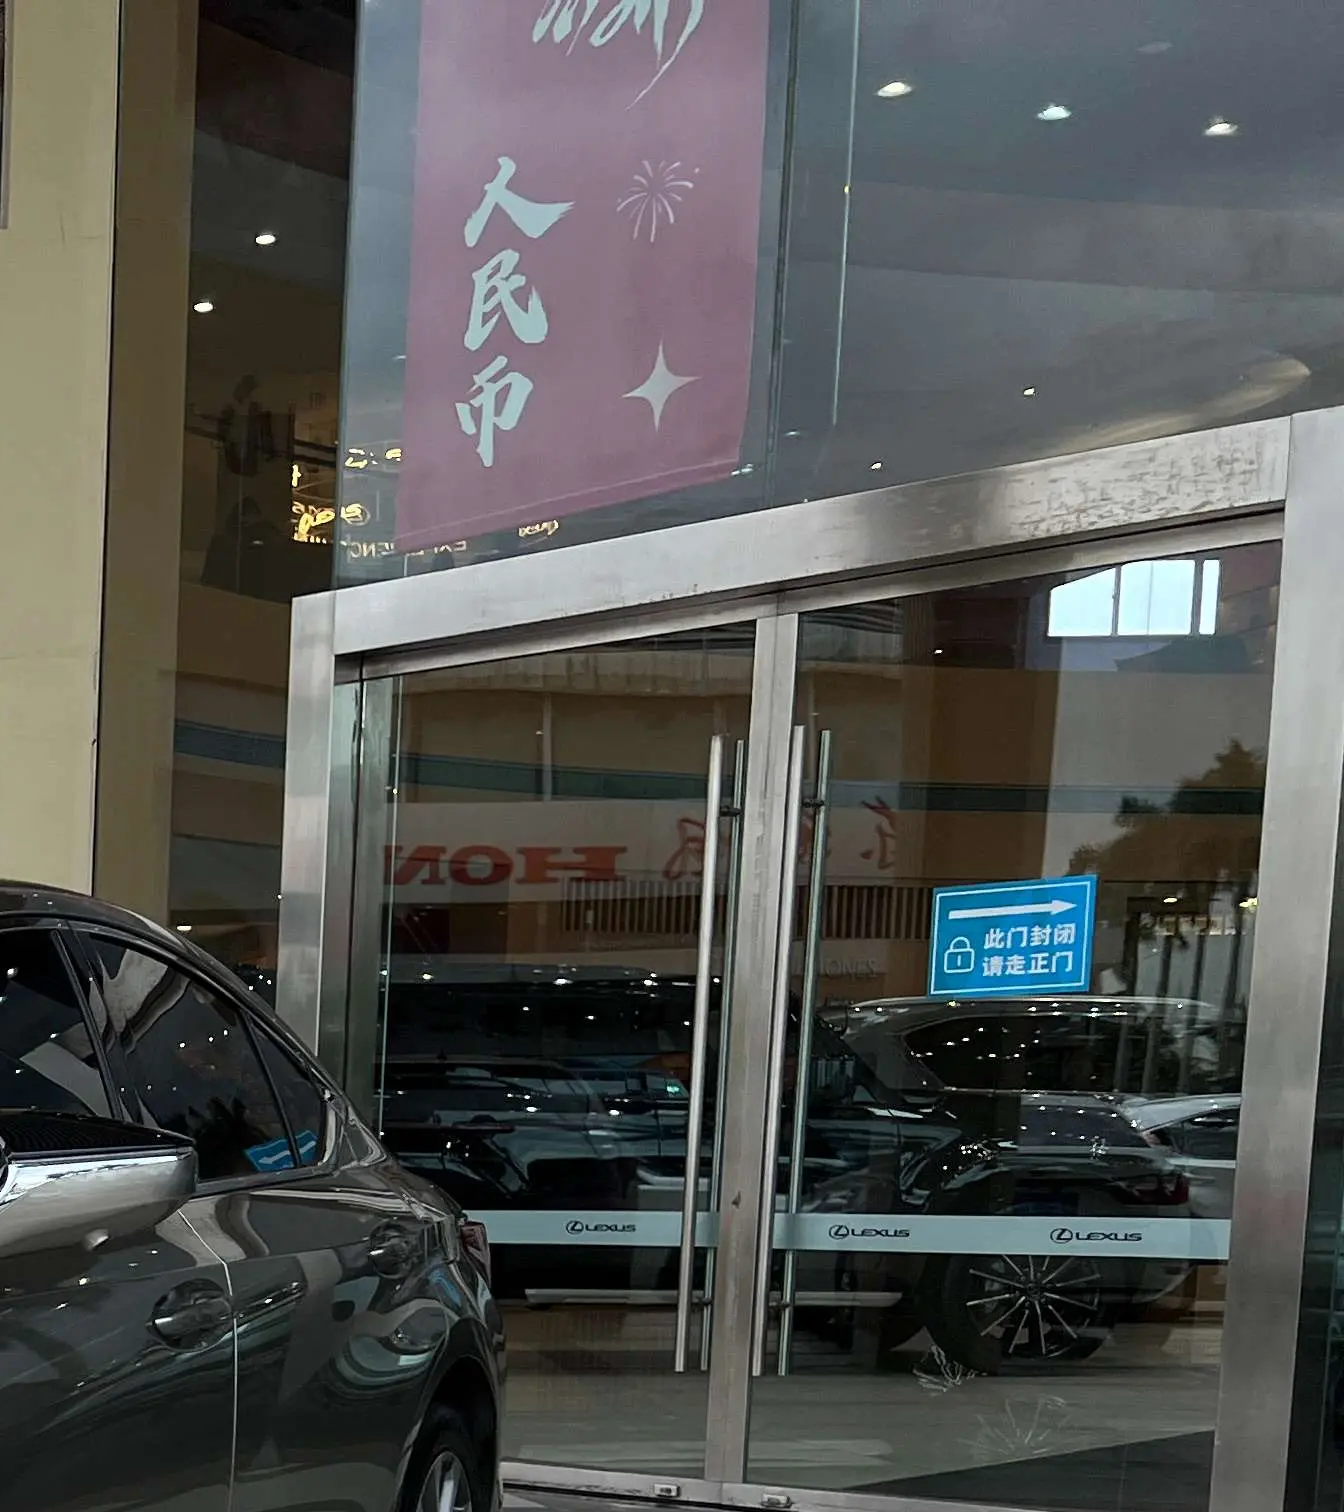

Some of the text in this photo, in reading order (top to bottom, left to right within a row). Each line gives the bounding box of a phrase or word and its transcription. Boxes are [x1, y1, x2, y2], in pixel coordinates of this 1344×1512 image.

[455, 156, 574, 468] 人民币
[983, 923, 1076, 949] 此门封闭
[982, 951, 1073, 977] 请走正门
[585, 1223, 636, 1233] LEXUS
[850, 1227, 911, 1238] LEXUS
[1074, 1231, 1143, 1242] LEXUS
